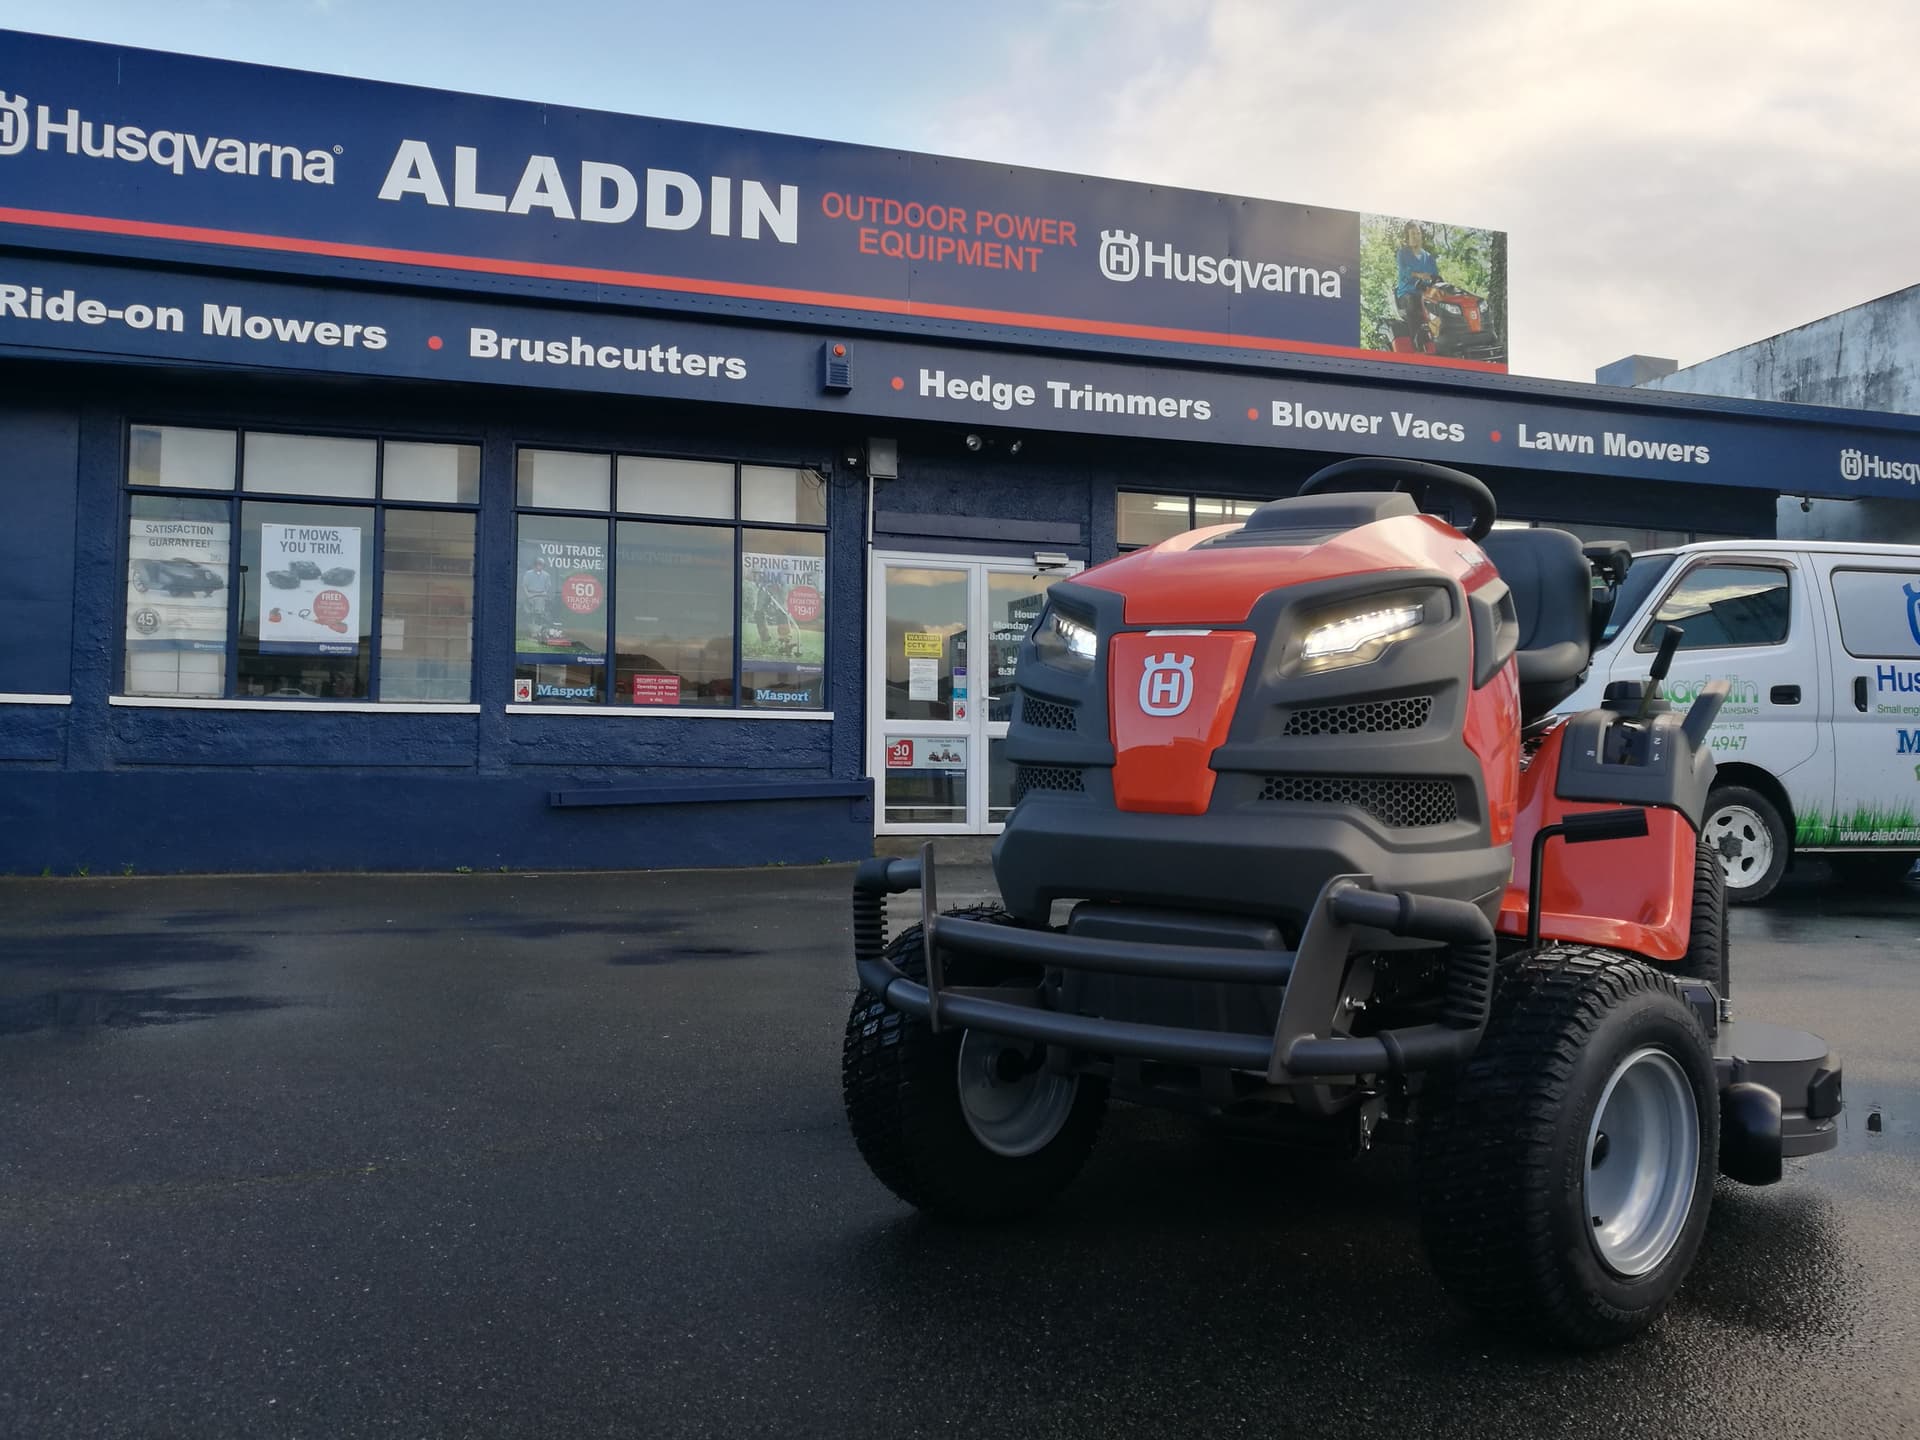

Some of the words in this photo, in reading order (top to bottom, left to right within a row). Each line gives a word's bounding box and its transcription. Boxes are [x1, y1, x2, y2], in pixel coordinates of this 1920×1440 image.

[378, 139, 799, 245] ALADDIN
[821, 192, 967, 235] OUTDOOR
[975, 211, 1077, 248] POWER
[859, 230, 1044, 273] EQUIPMENT
[0, 284, 183, 332] Ride-on
[203, 303, 388, 350] Mowers
[469, 327, 747, 380] Brushcutters
[919, 368, 1036, 411] Hedge
[1047, 380, 1212, 420] Trimmers
[1271, 400, 1382, 435] Blower
[1391, 411, 1465, 442] Vacs
[1518, 423, 1594, 454] Lawn
[1604, 431, 1710, 464] Mowers
[145, 524, 214, 536] SATISFACTION
[284, 528, 297, 540] IT
[300, 528, 342, 543] MOWS,
[148, 538, 210, 549] GUARANTEE!
[280, 541, 306, 553] YOU
[309, 543, 344, 555] TRIM.
[540, 543, 563, 555] YOU
[547, 557, 570, 569] YOU
[743, 556, 789, 570] SPRING
[792, 559, 824, 573] TIME,
[137, 613, 154, 626] 45
[536, 684, 595, 698] Masport
[756, 689, 809, 703] Masport
[1877, 703, 1901, 714] Small
[893, 744, 910, 756] 30
[1711, 735, 1748, 751] 4947
